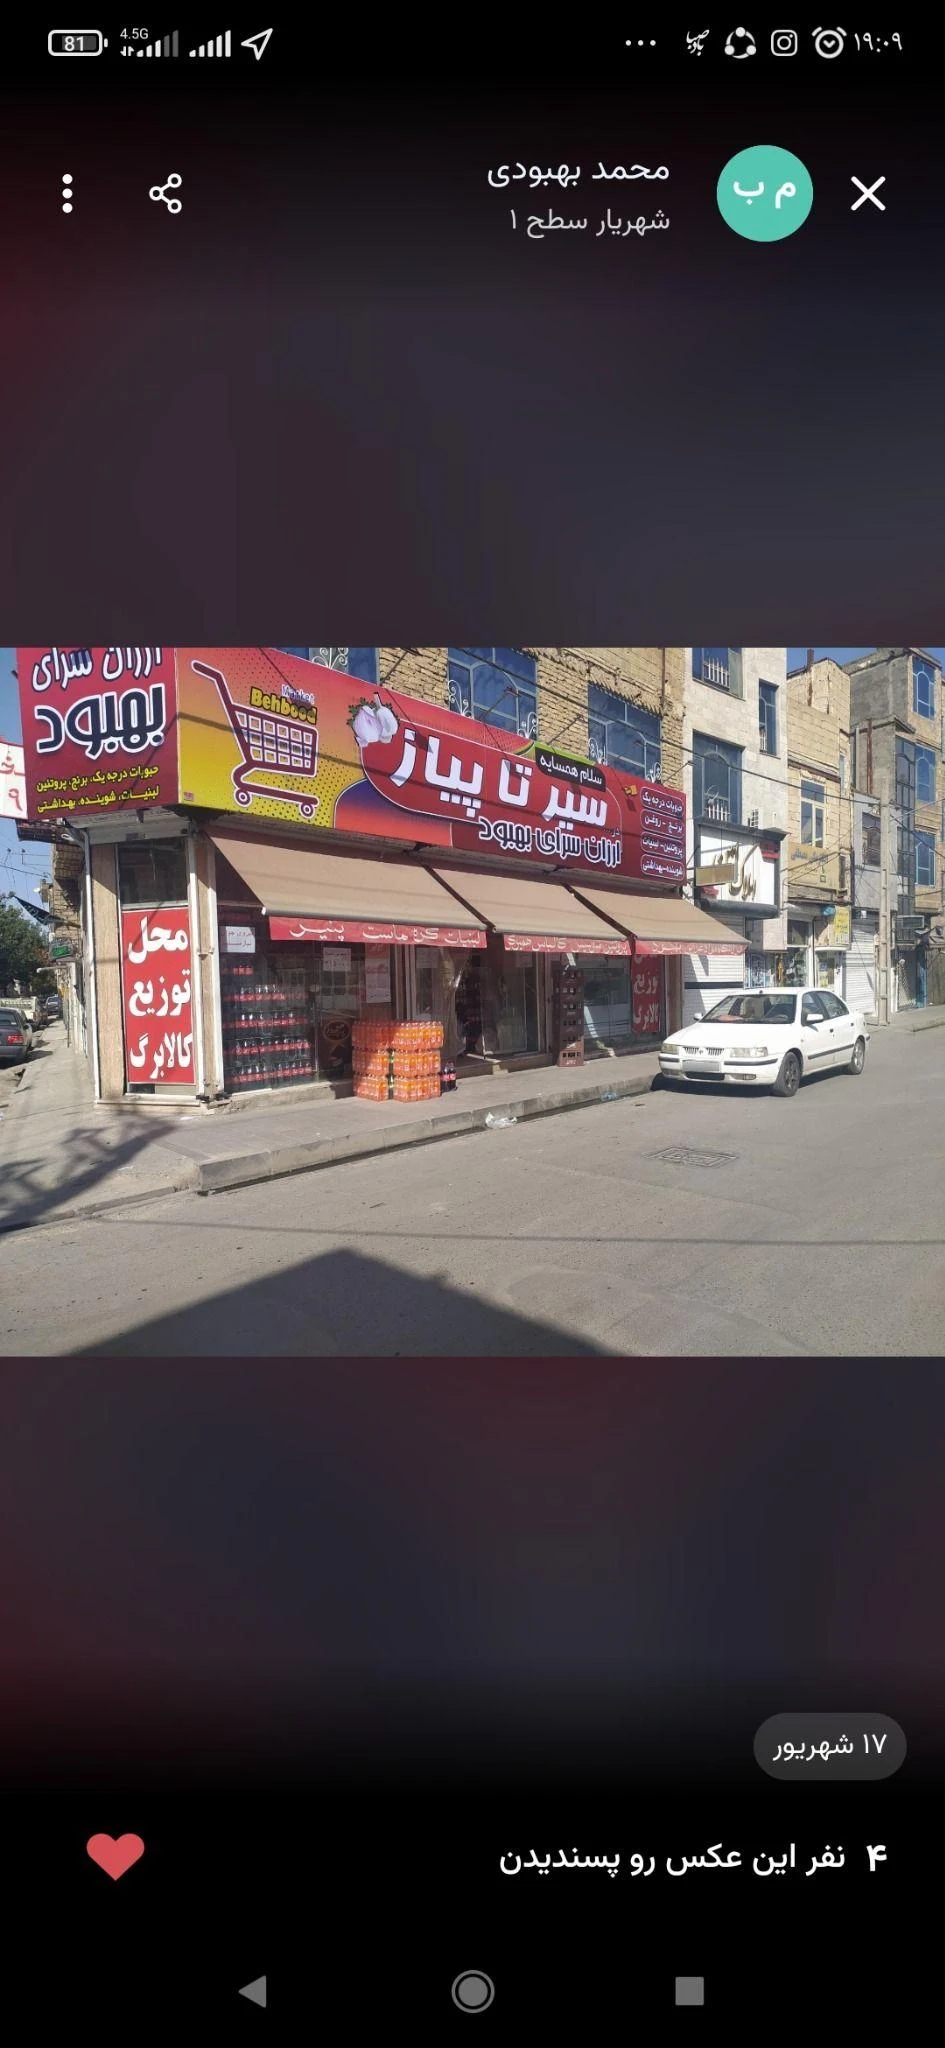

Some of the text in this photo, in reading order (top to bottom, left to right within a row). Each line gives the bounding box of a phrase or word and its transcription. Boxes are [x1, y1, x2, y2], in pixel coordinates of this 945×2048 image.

[249, 686, 317, 725] Behbood
[34, 683, 166, 760] بهبود
[106, 769, 128, 783] درجه
[130, 764, 159, 780] حبوبات
[389, 728, 607, 830] سیر تا پیاز
[540, 754, 603, 785] سلام همسایه
[37, 797, 76, 813] بهداشتی
[478, 816, 621, 868] ارزان سرای بهبود
[128, 916, 189, 964] محل
[289, 920, 345, 941] پنیر
[362, 924, 409, 942] ماست
[443, 930, 481, 948] لبنیات
[128, 969, 191, 1017] توزیع
